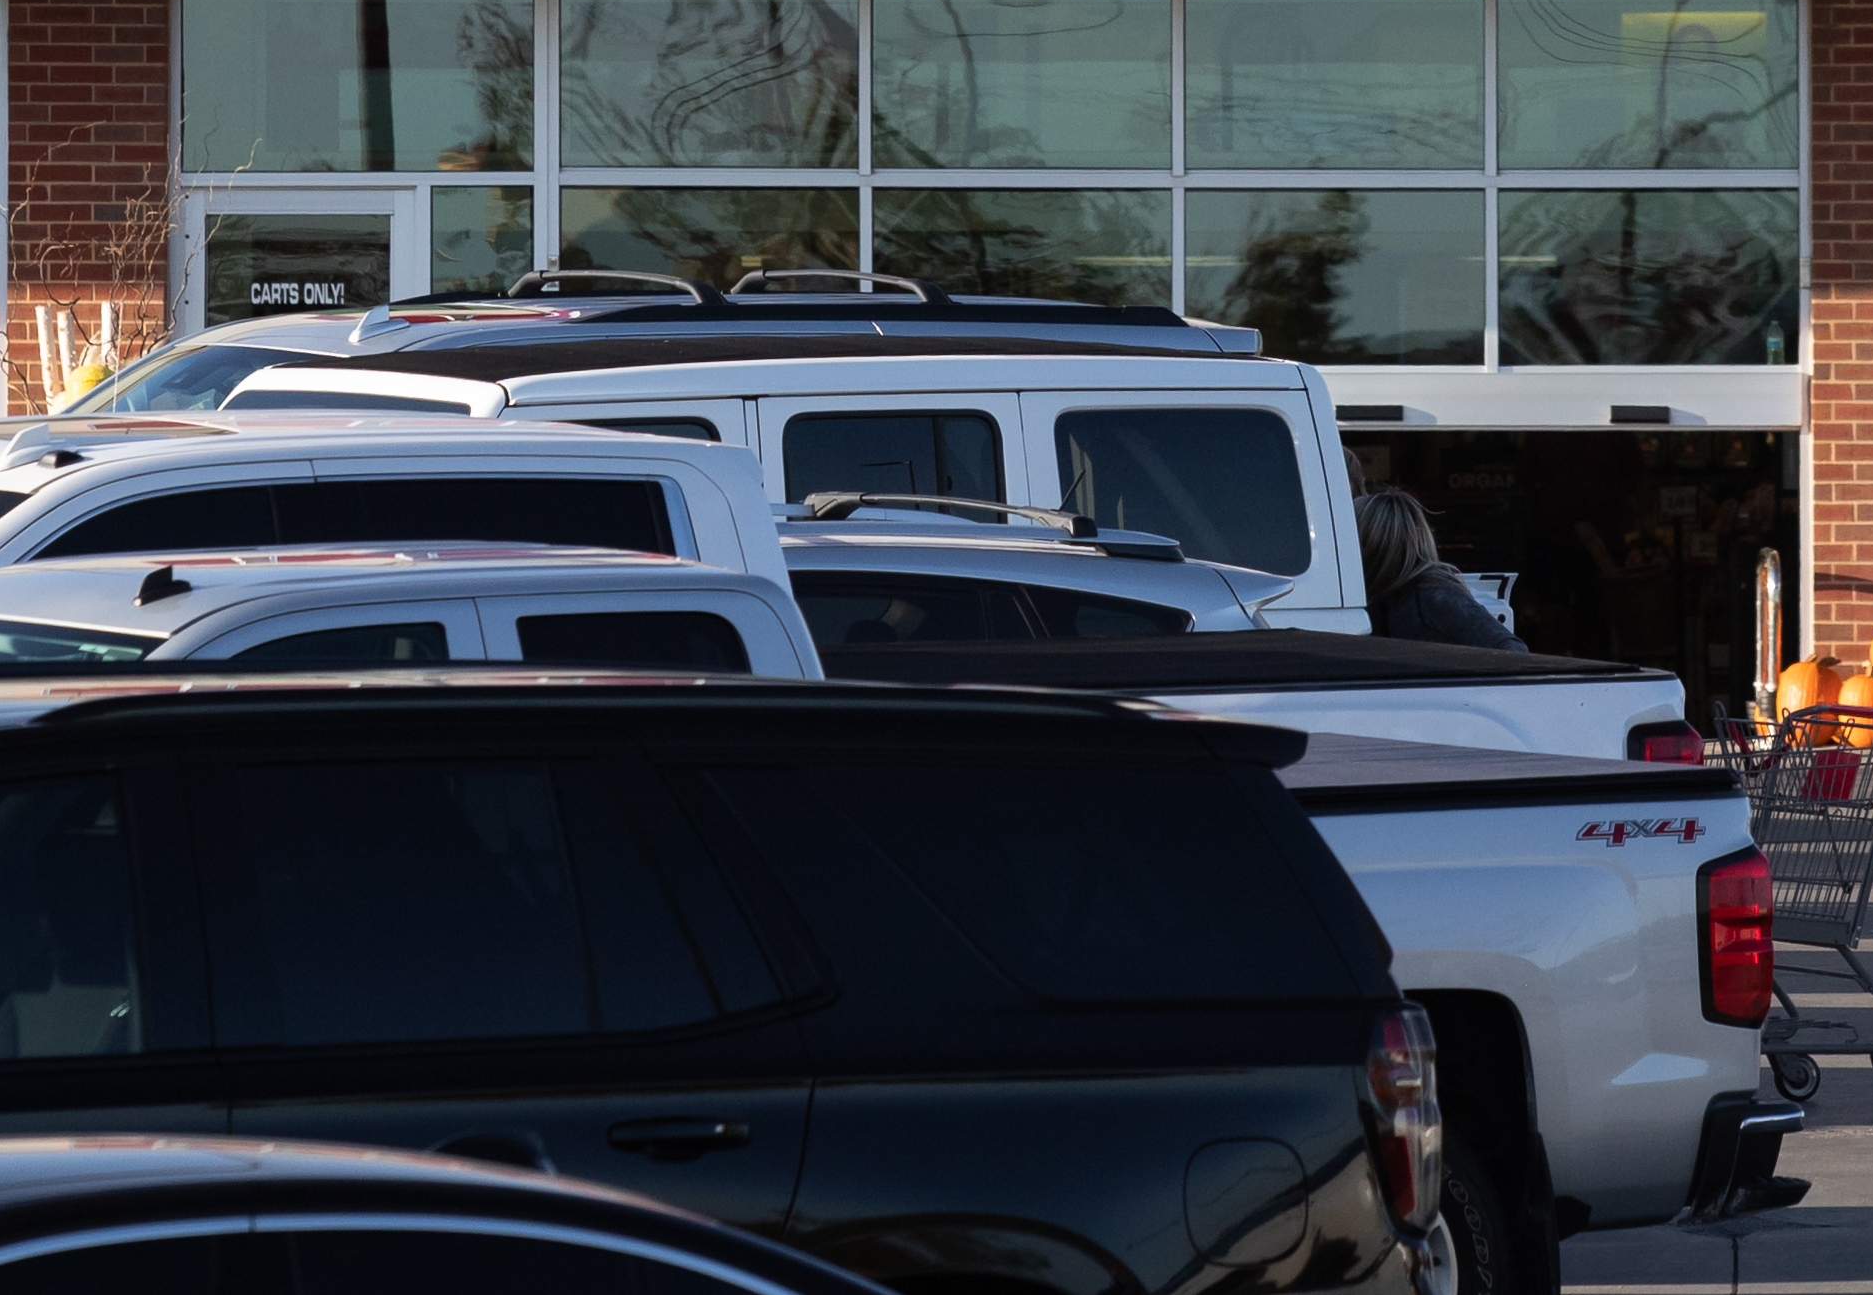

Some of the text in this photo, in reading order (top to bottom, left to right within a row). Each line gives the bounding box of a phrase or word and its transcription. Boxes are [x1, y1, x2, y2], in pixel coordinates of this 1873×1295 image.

[251, 282, 345, 305] CARTS ONLY!
[1448, 472, 1516, 489] ORGAN
